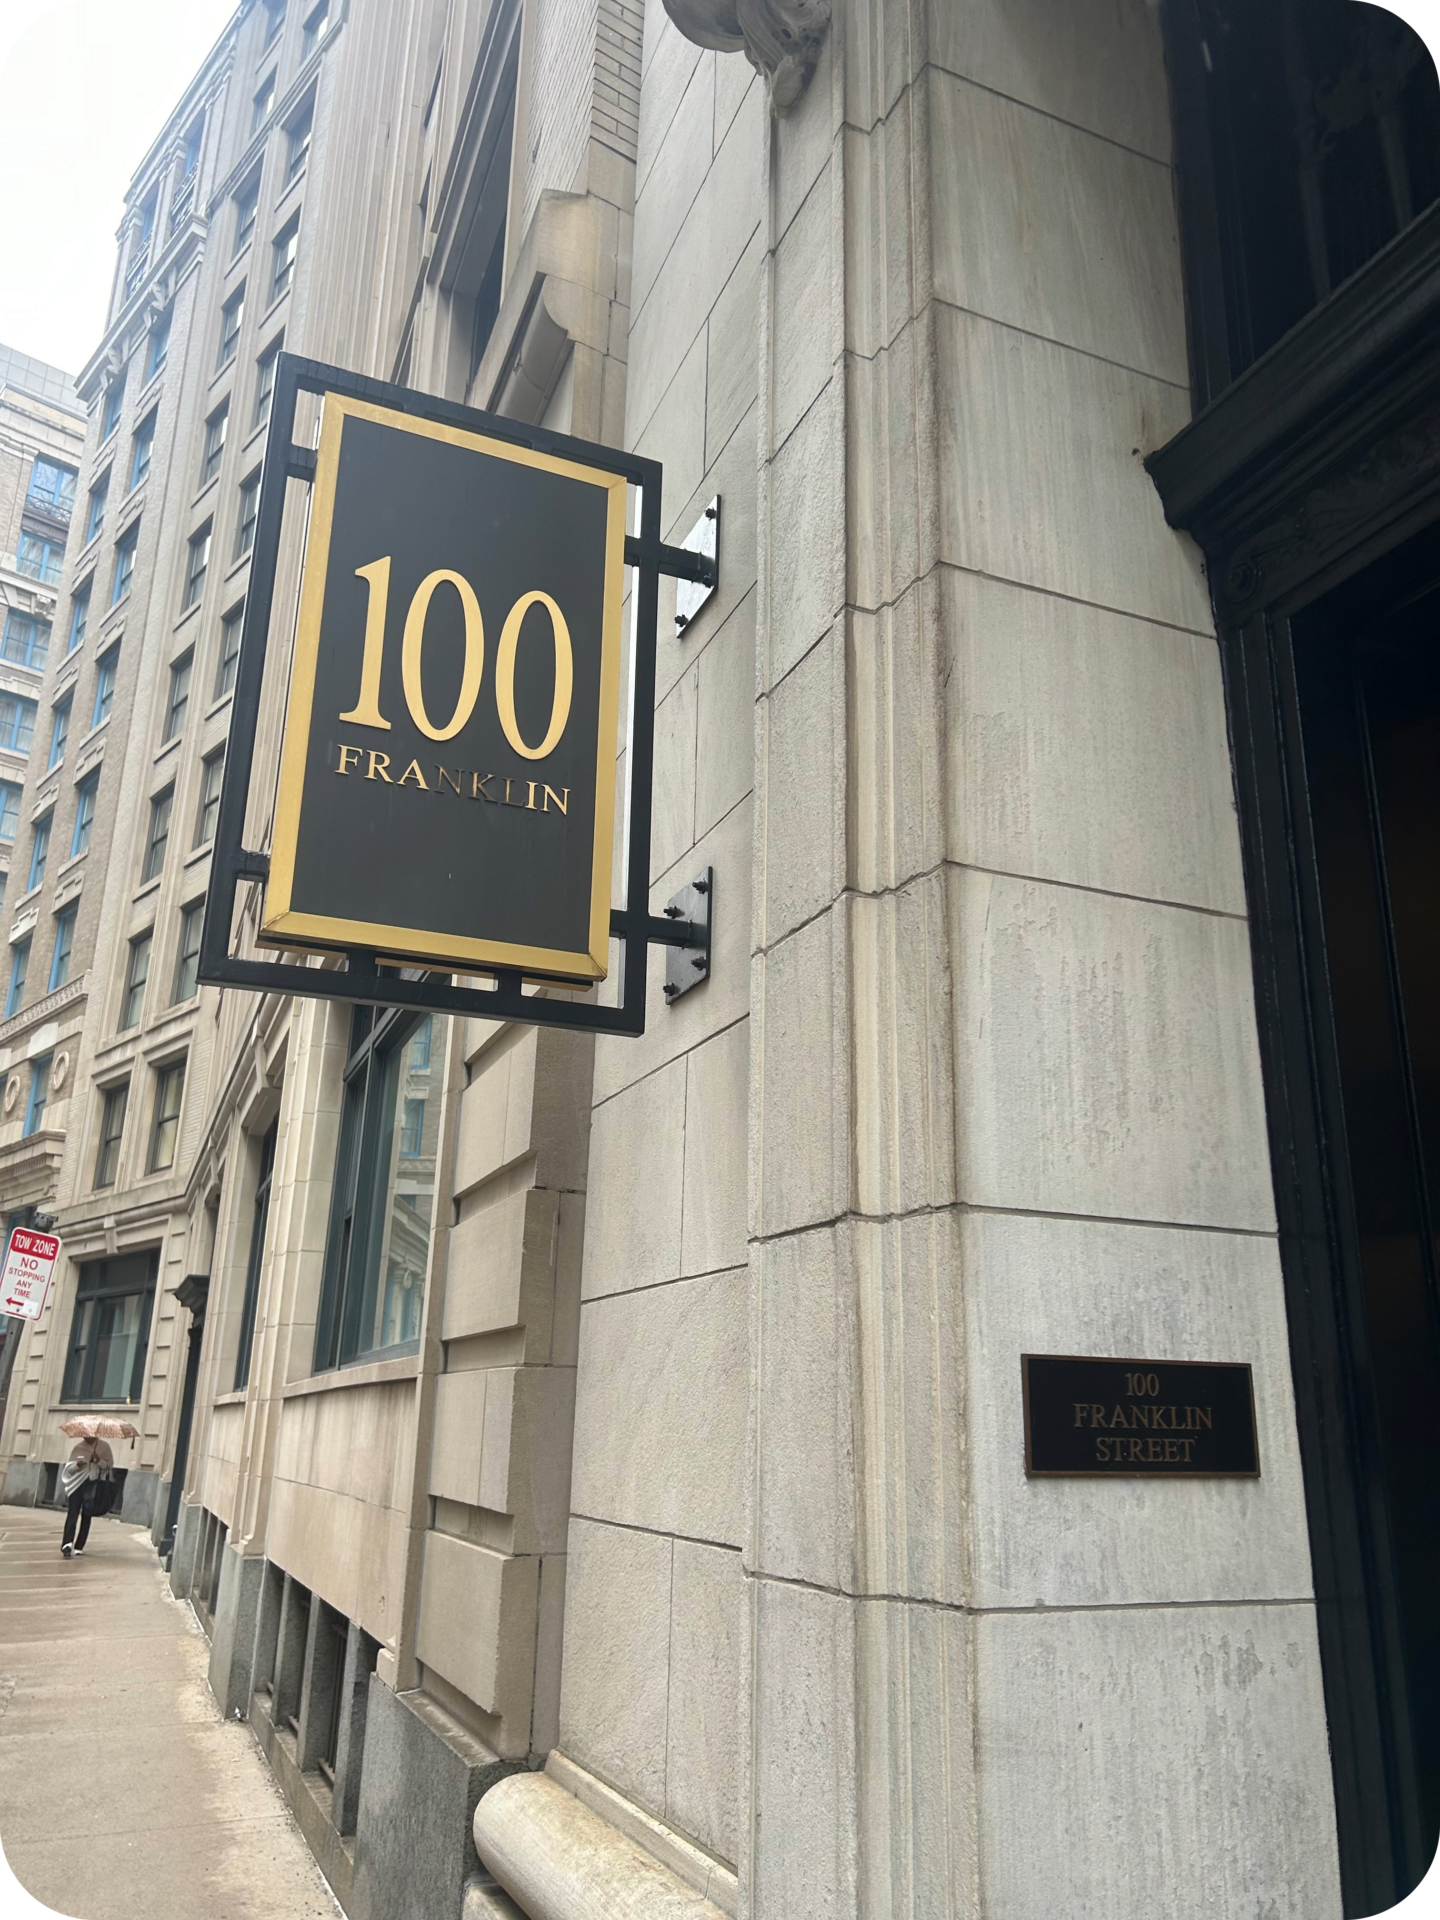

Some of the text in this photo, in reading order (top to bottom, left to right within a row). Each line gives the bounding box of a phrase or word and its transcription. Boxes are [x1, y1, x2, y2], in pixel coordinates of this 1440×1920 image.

[339, 555, 574, 760] 100
[335, 744, 571, 815] FRANKLIN
[15, 1234, 56, 1256] TOW ZONE
[8, 1267, 46, 1283] STOPPING
[20, 1257, 39, 1270] NO
[13, 1287, 32, 1299] TIME
[16, 1279, 33, 1289] ANY
[1124, 1373, 1160, 1397] 100
[1073, 1403, 1212, 1430] FRANKLIN
[1096, 1437, 1195, 1462] STREET
